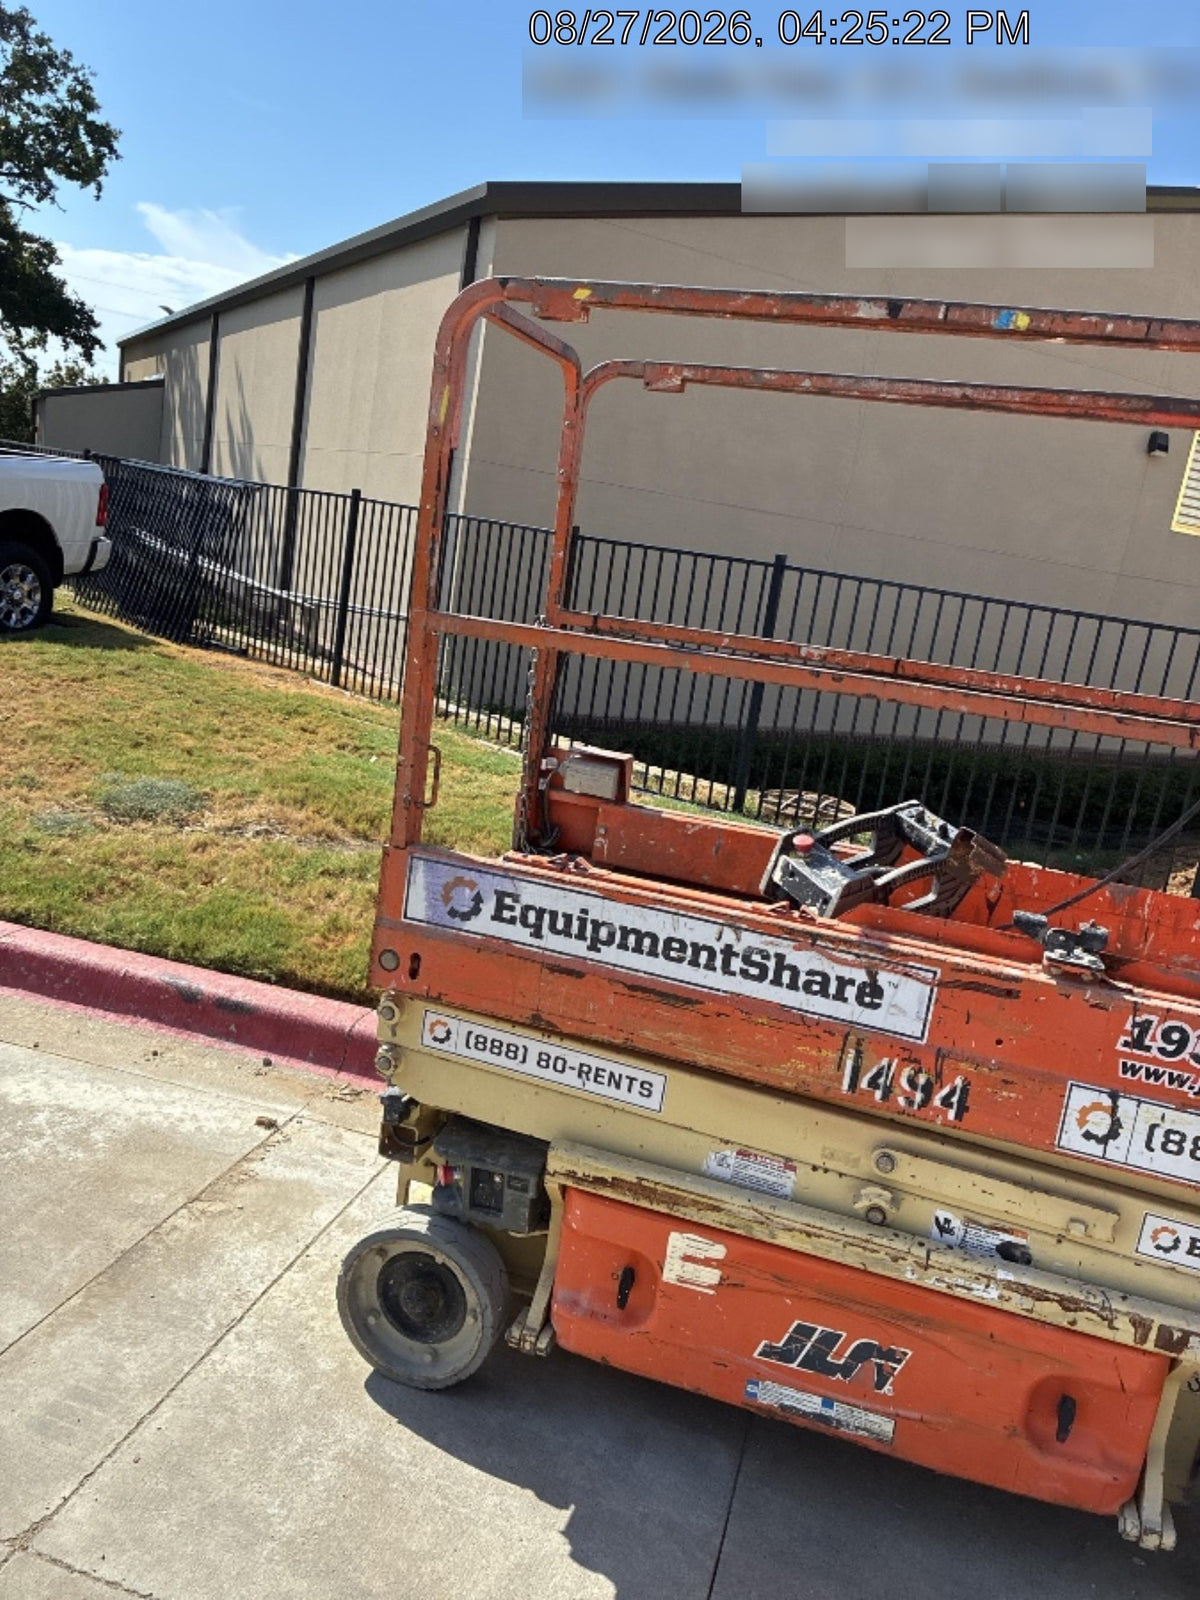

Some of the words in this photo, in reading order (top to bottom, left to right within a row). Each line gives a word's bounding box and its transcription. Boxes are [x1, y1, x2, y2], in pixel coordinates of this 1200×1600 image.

[490, 888, 885, 1011] EquipmentShare
[464, 1033, 528, 1064] (888)
[535, 1050, 655, 1099] 80-RENTS
[841, 1048, 971, 1122] 1494
